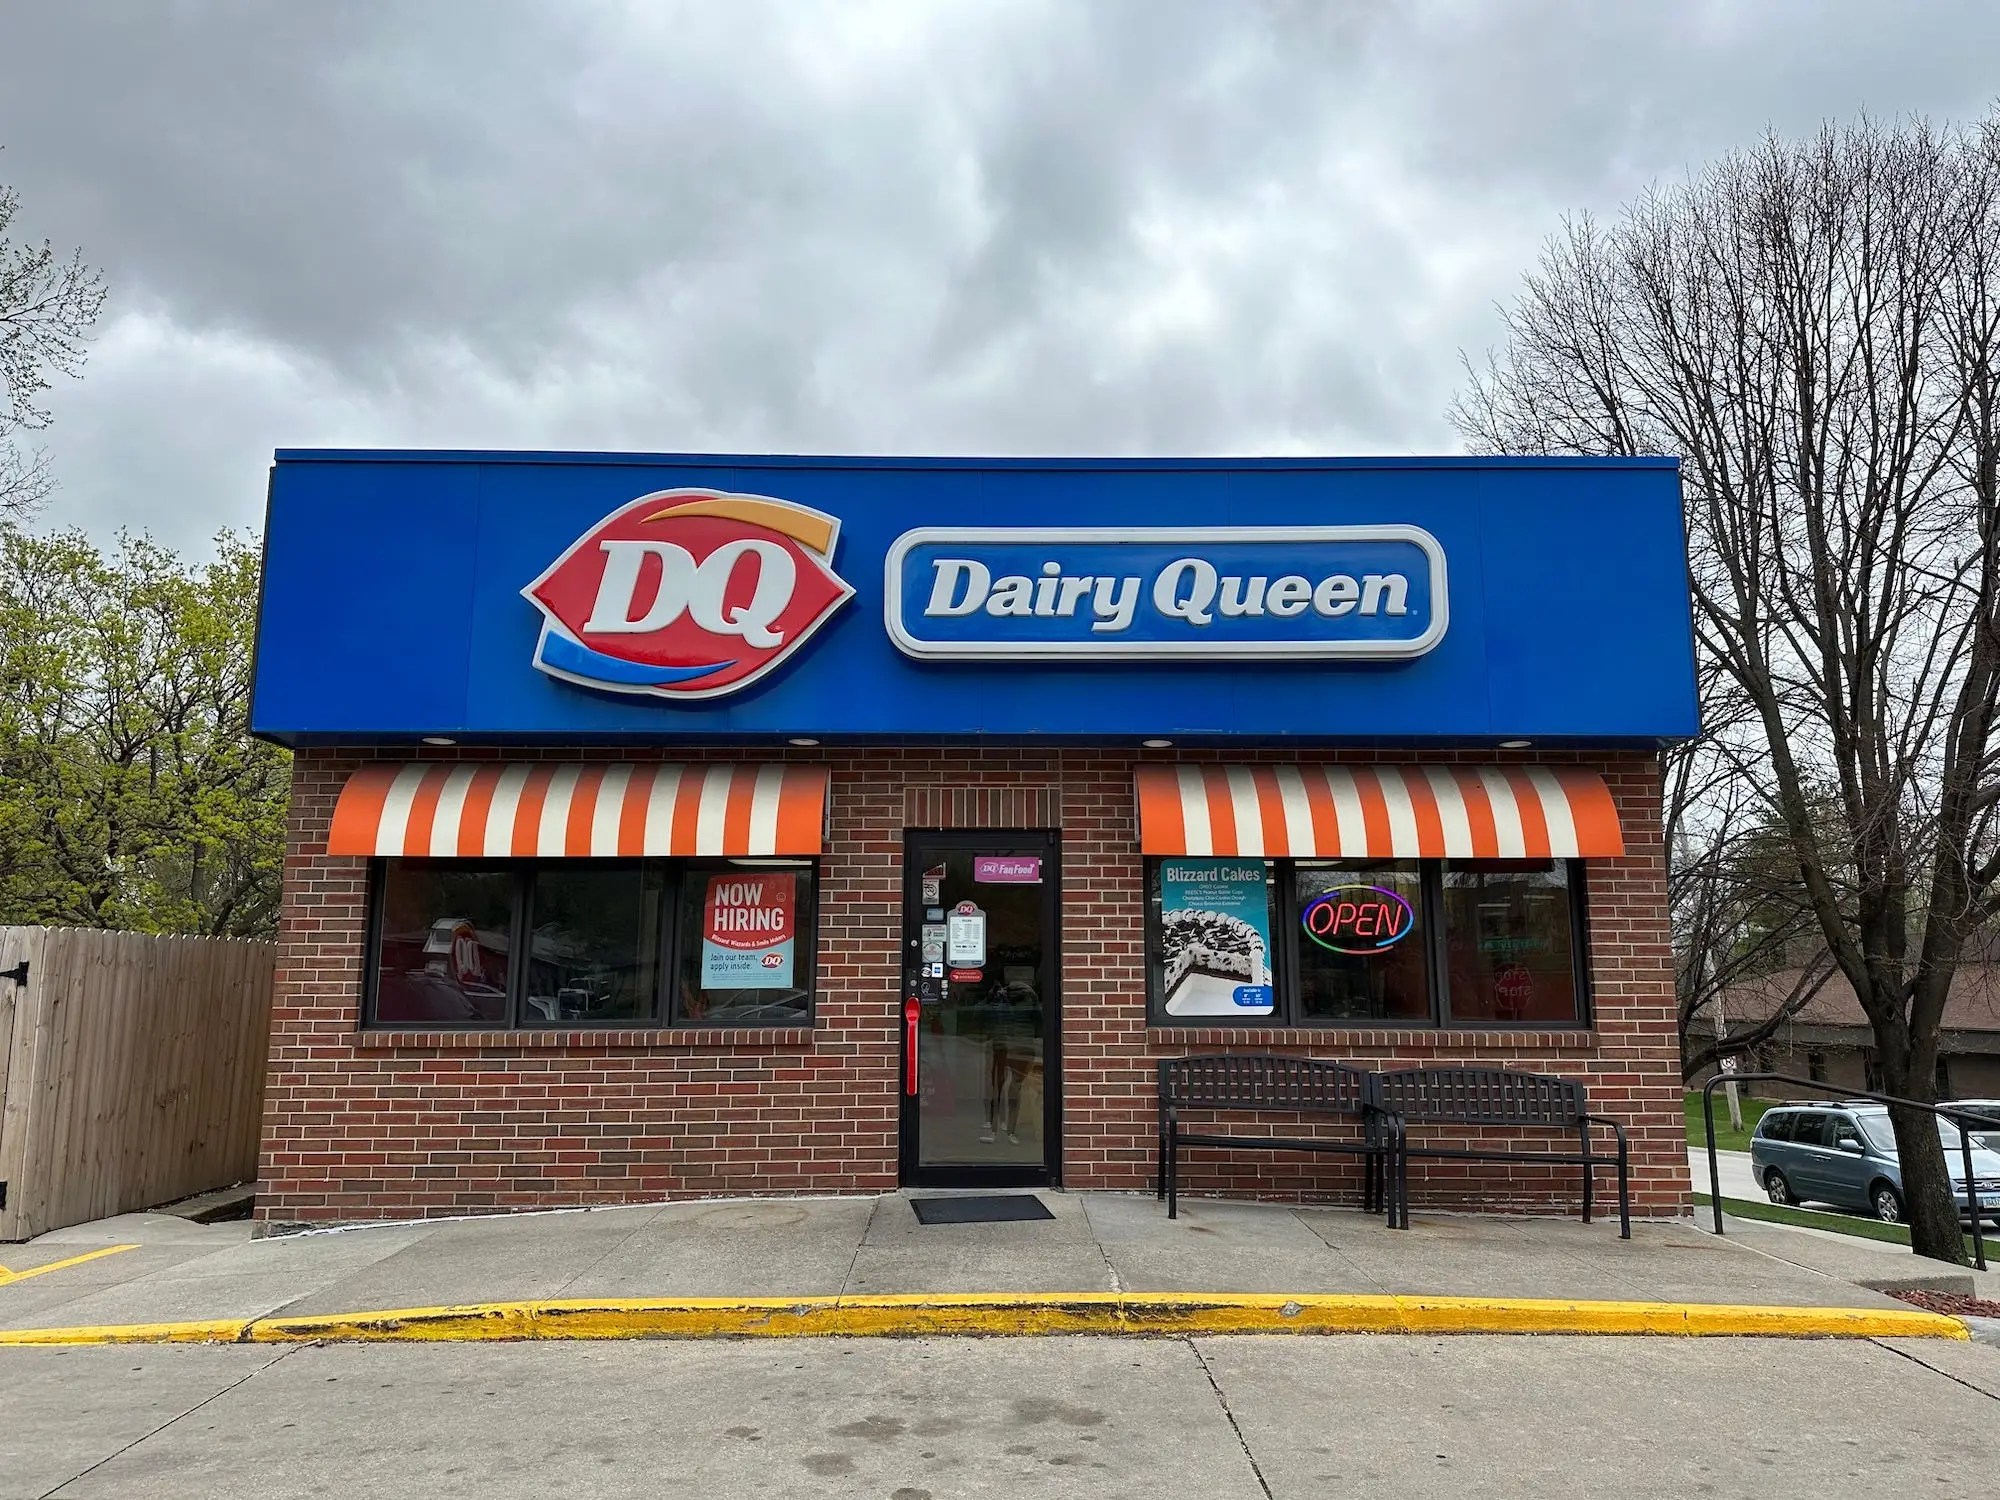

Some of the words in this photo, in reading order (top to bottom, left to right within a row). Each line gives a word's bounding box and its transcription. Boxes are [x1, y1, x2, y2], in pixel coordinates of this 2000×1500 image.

[583, 538, 797, 649] DQ
[923, 558, 1142, 633] Dairy
[1153, 558, 1408, 626] Queen
[1166, 867, 1218, 882] Blizzard
[1220, 867, 1261, 882] Cakes
[715, 883, 763, 906] NOW
[713, 907, 785, 932] HIRING
[959, 904, 973, 913] DQ
[1309, 903, 1403, 936] OPEN
[710, 953, 724, 961] Join
[710, 962, 729, 972] apply
